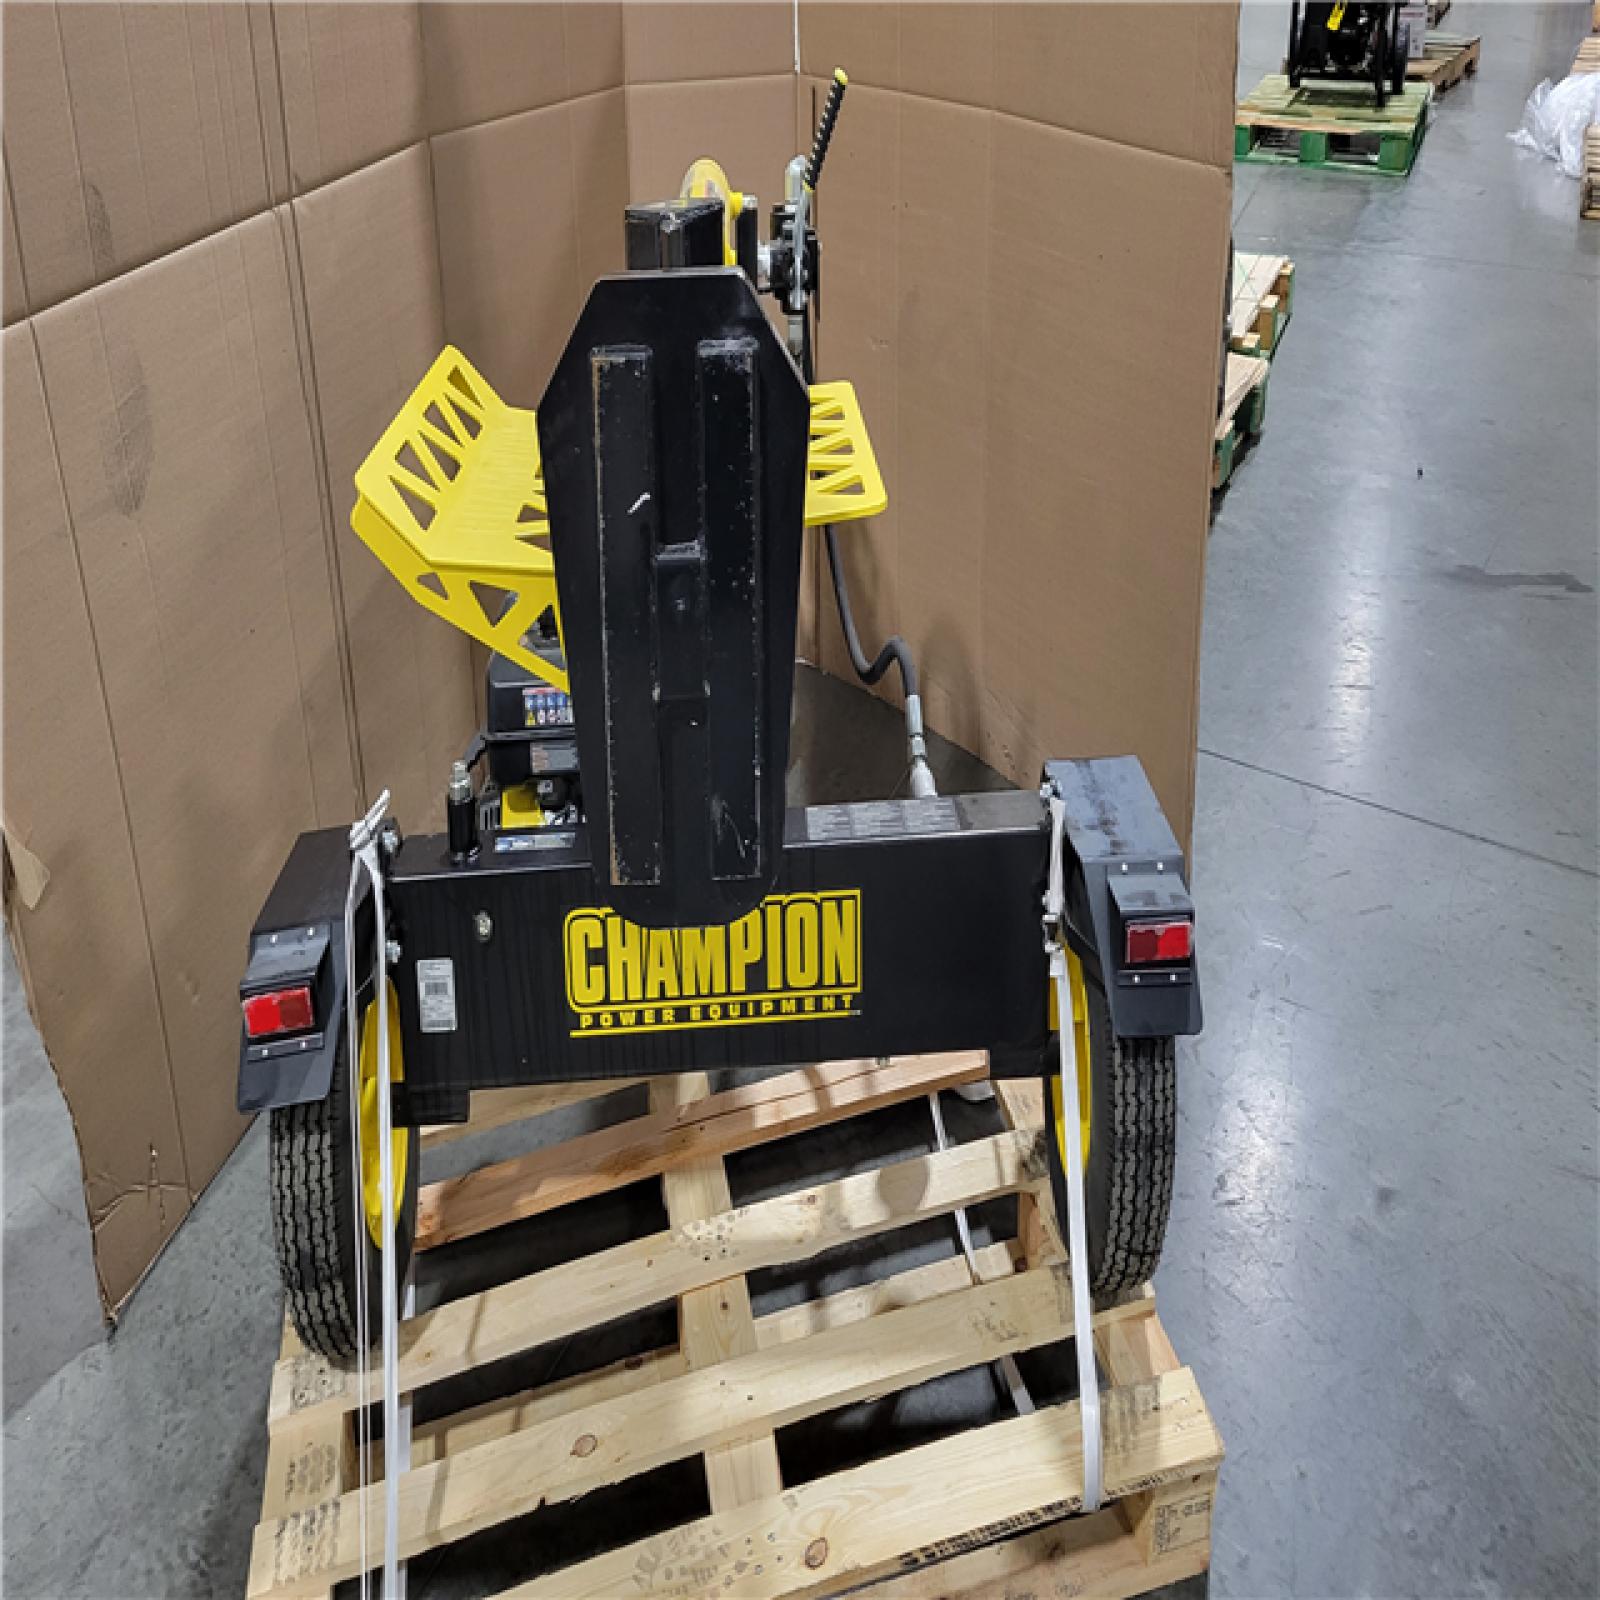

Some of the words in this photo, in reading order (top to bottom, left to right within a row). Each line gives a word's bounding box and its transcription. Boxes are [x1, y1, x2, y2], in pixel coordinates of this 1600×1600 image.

[570, 899, 857, 1005] CHAMPION
[580, 1008, 676, 1029] POWER
[689, 994, 854, 1020] EQUIPMENT
